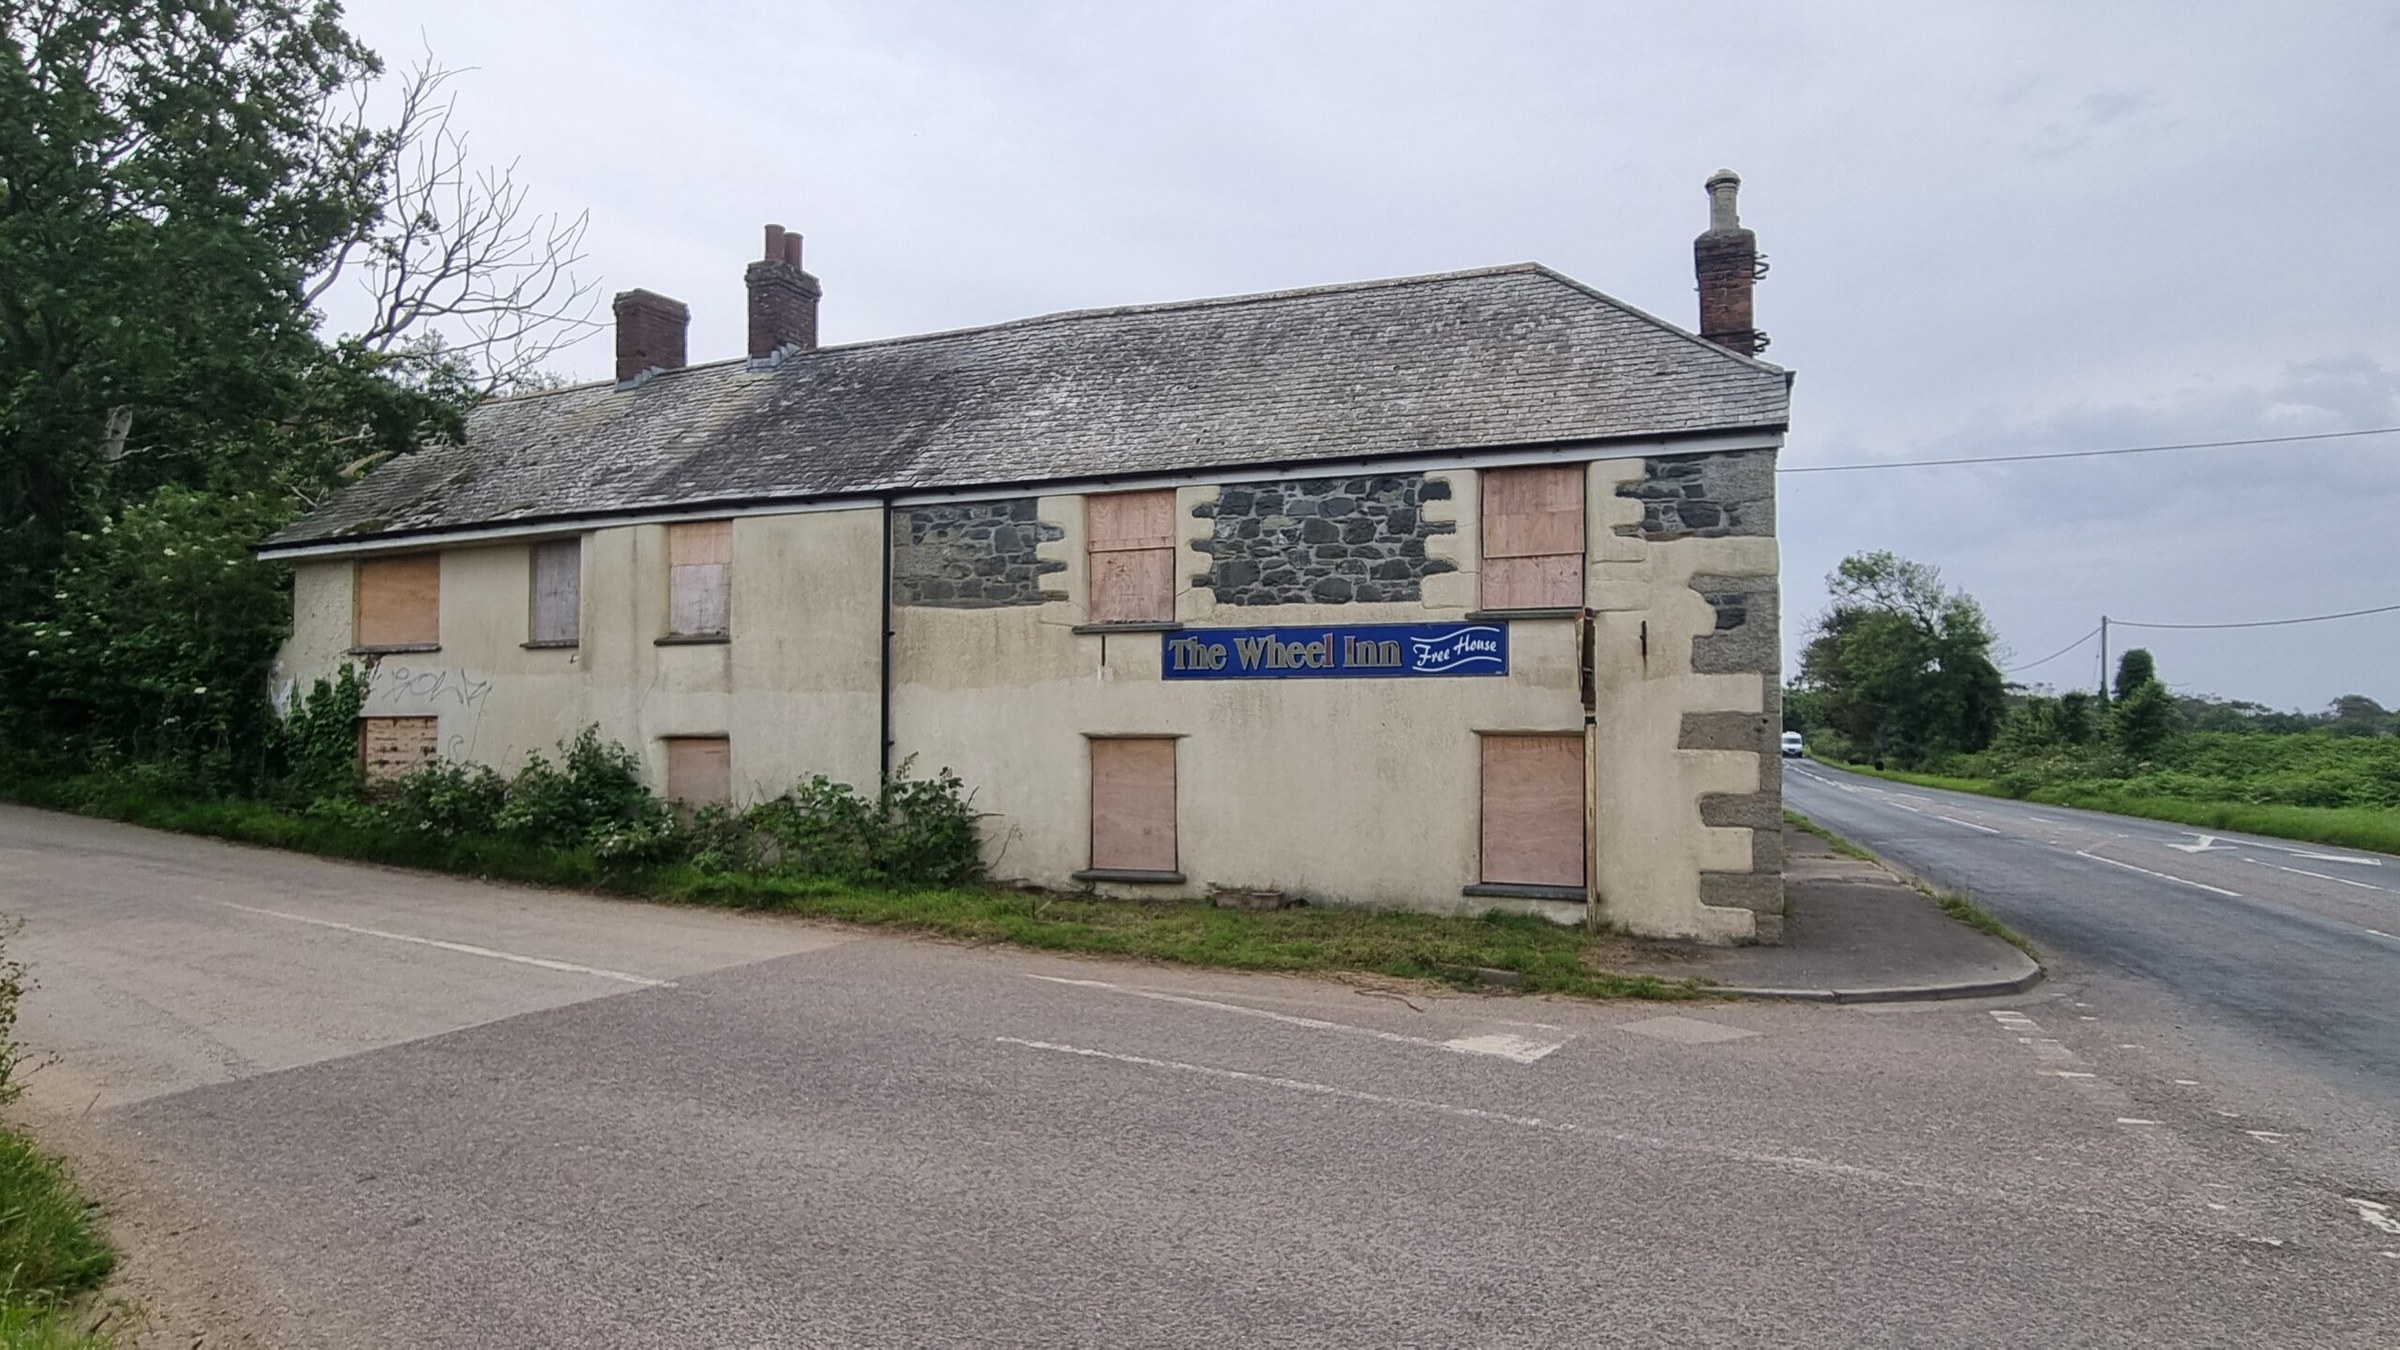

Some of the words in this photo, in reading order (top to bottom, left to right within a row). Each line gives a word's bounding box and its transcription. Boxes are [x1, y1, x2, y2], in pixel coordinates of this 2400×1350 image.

[1168, 635, 1228, 671] The
[1233, 633, 1335, 671] Wheel
[1342, 635, 1402, 668] Inn
[1412, 643, 1450, 667] Free
[1453, 633, 1498, 655] House
